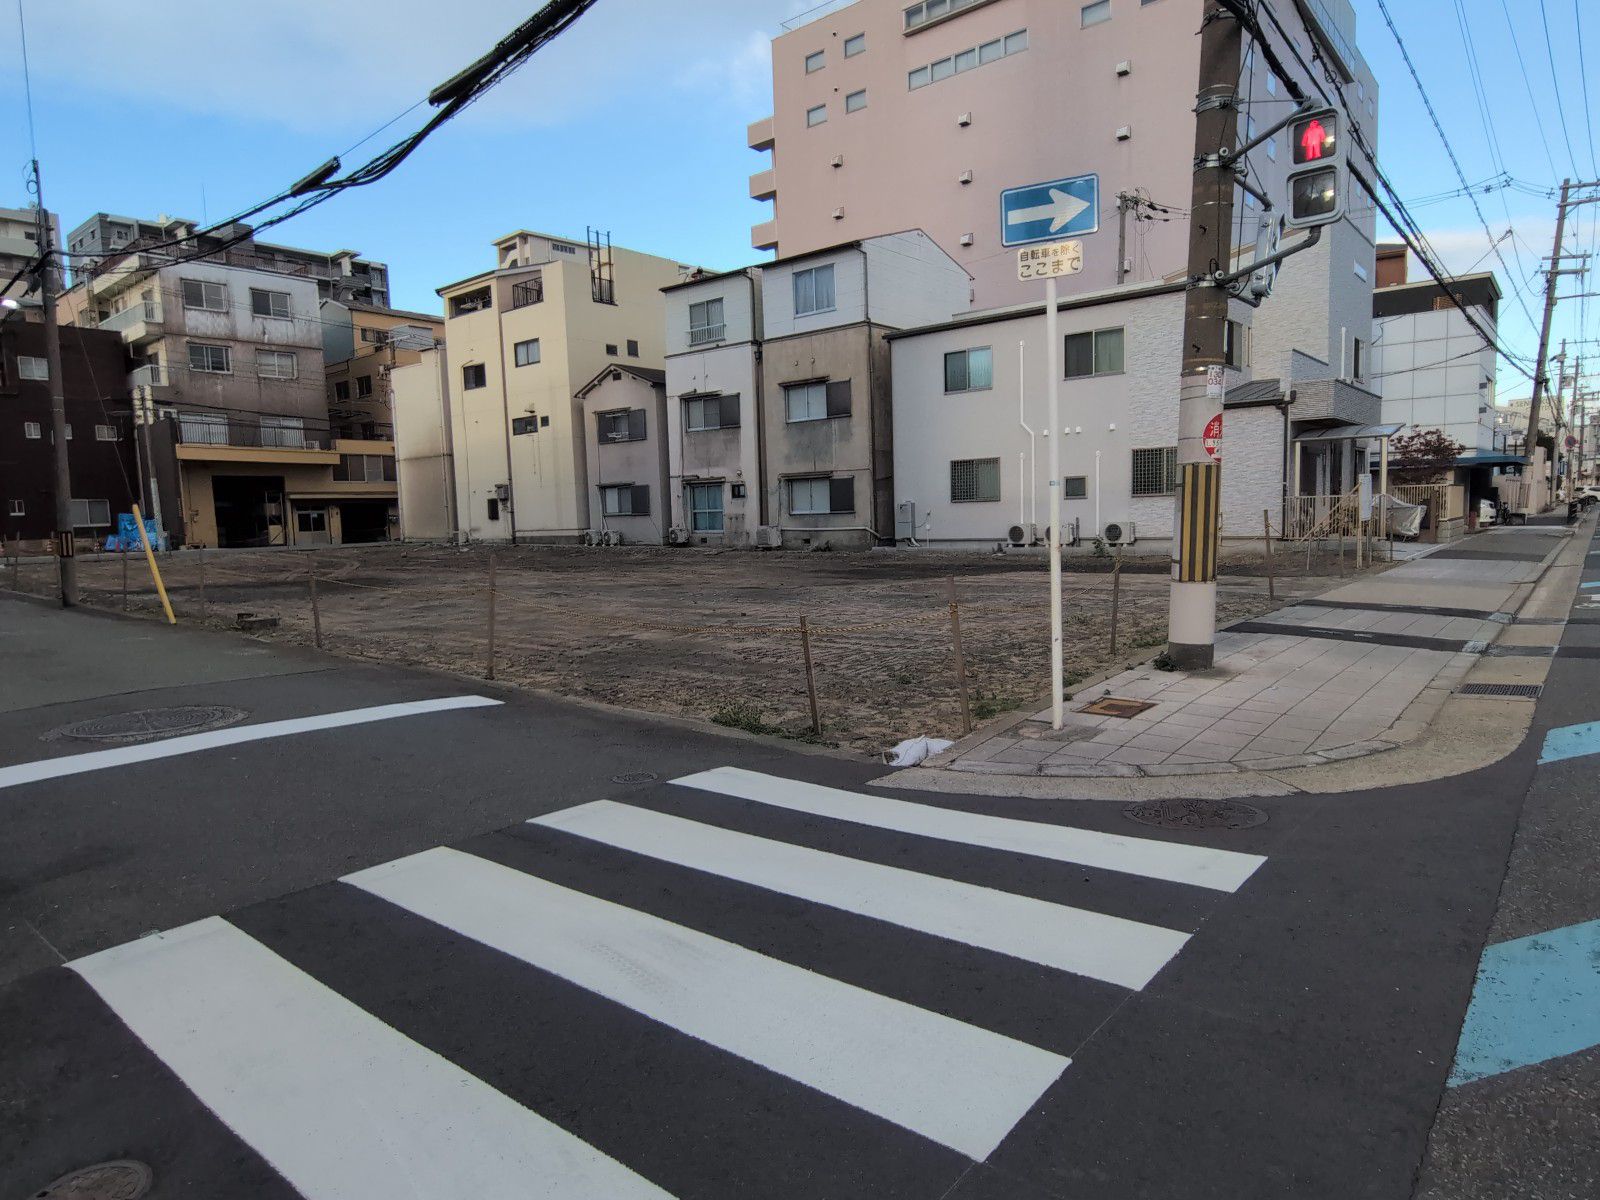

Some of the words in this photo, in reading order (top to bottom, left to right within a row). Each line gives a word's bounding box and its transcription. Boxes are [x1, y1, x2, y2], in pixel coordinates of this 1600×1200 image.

[1021, 244, 1080, 261] 自転車を除く
[1021, 257, 1080, 278] ここまで
